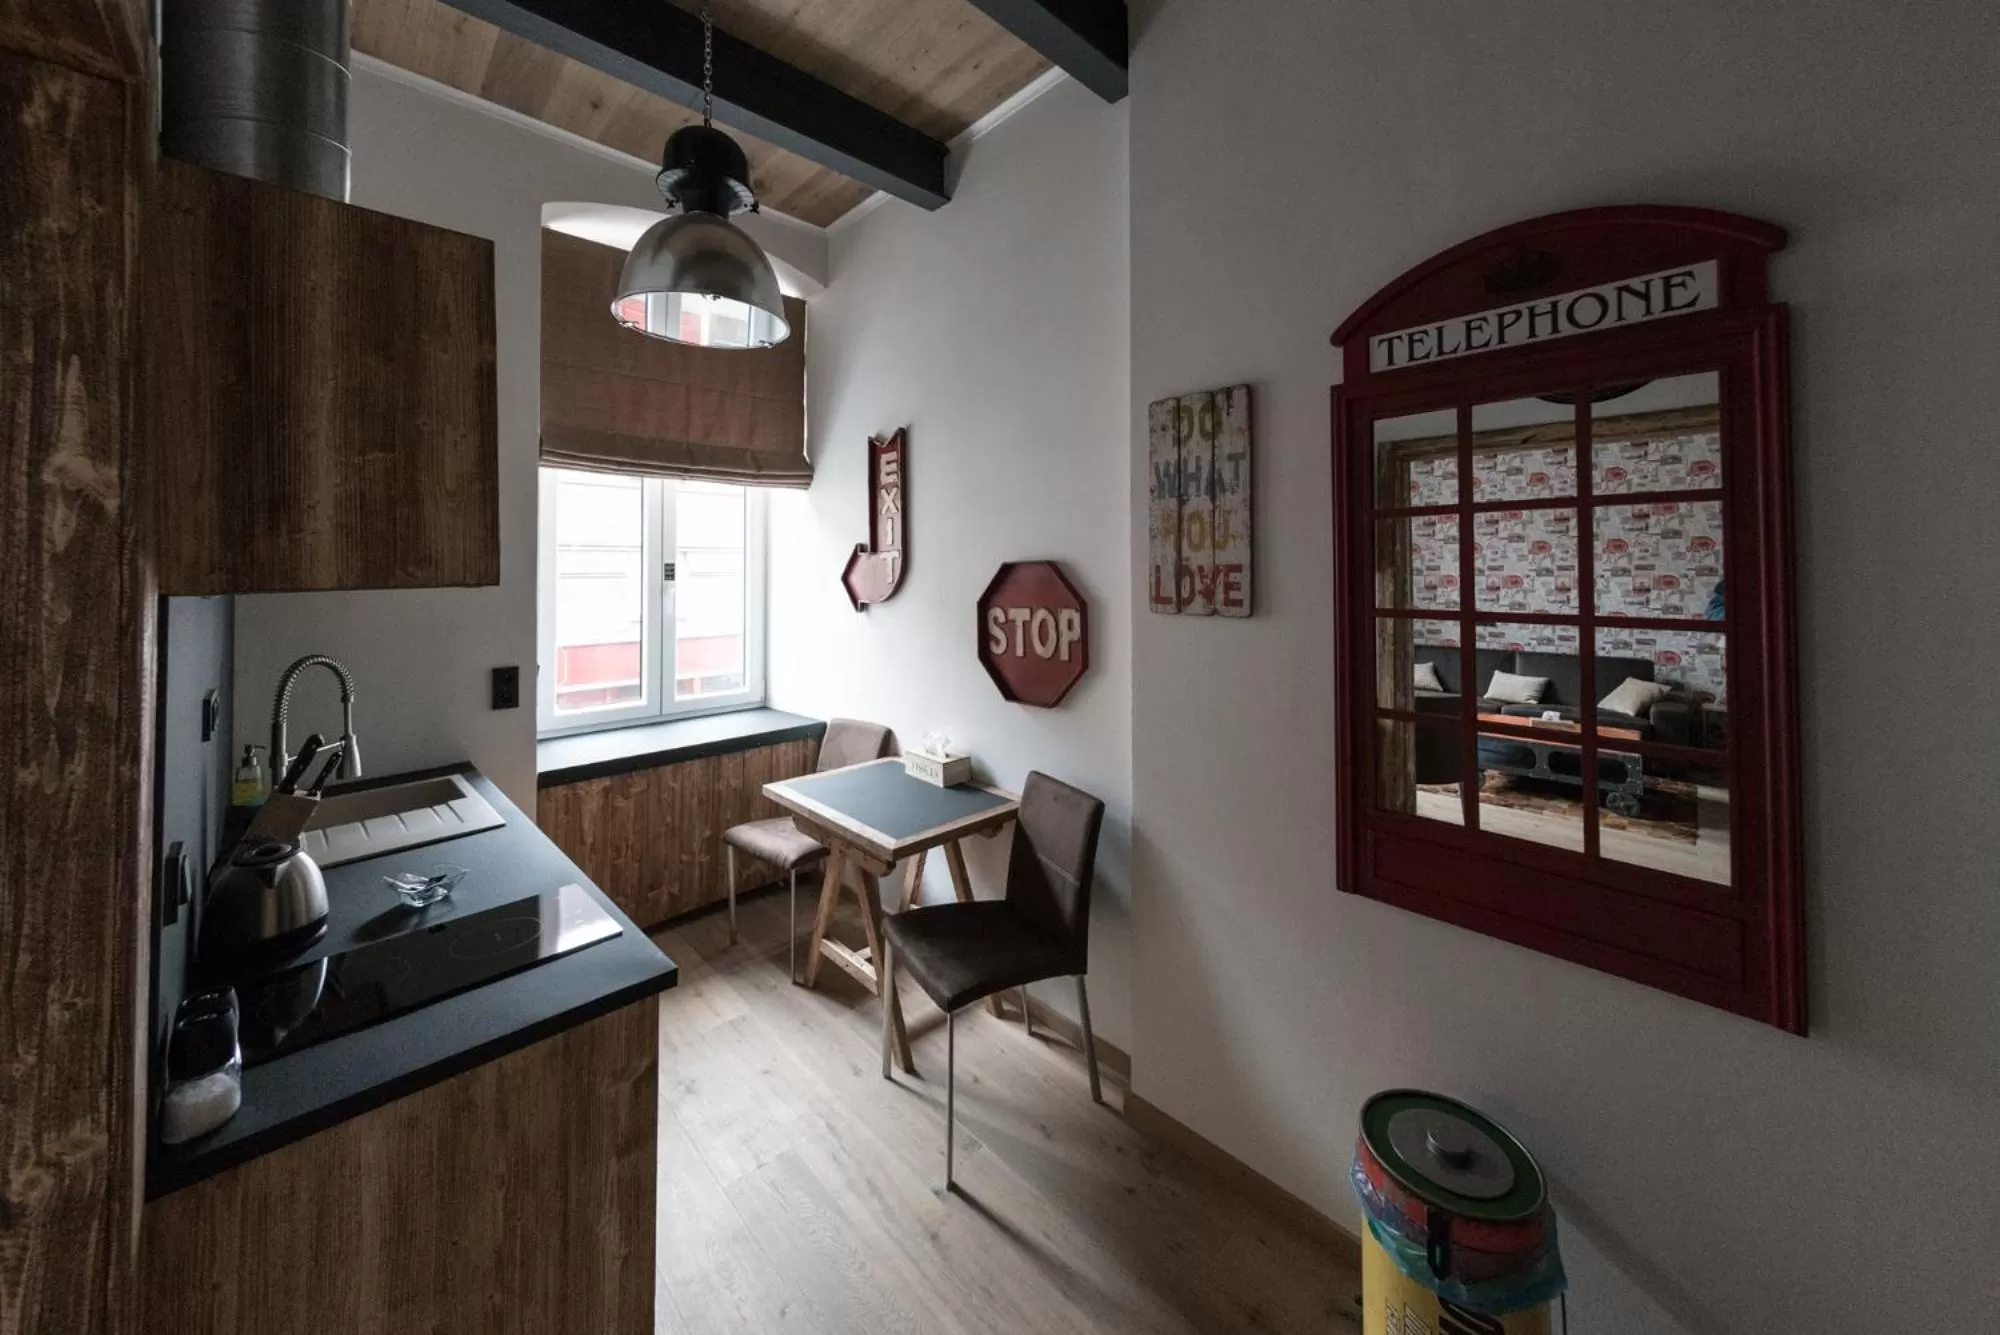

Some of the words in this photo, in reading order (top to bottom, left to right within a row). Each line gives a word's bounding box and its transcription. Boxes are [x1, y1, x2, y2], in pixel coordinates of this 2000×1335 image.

[1377, 270, 1701, 367] TELEPHONE
[1172, 402, 1223, 446] DO
[1154, 450, 1247, 500] WHAT
[879, 451, 900, 585] EXIT
[1152, 563, 1244, 608] LOVE
[987, 606, 1081, 662] STOP
